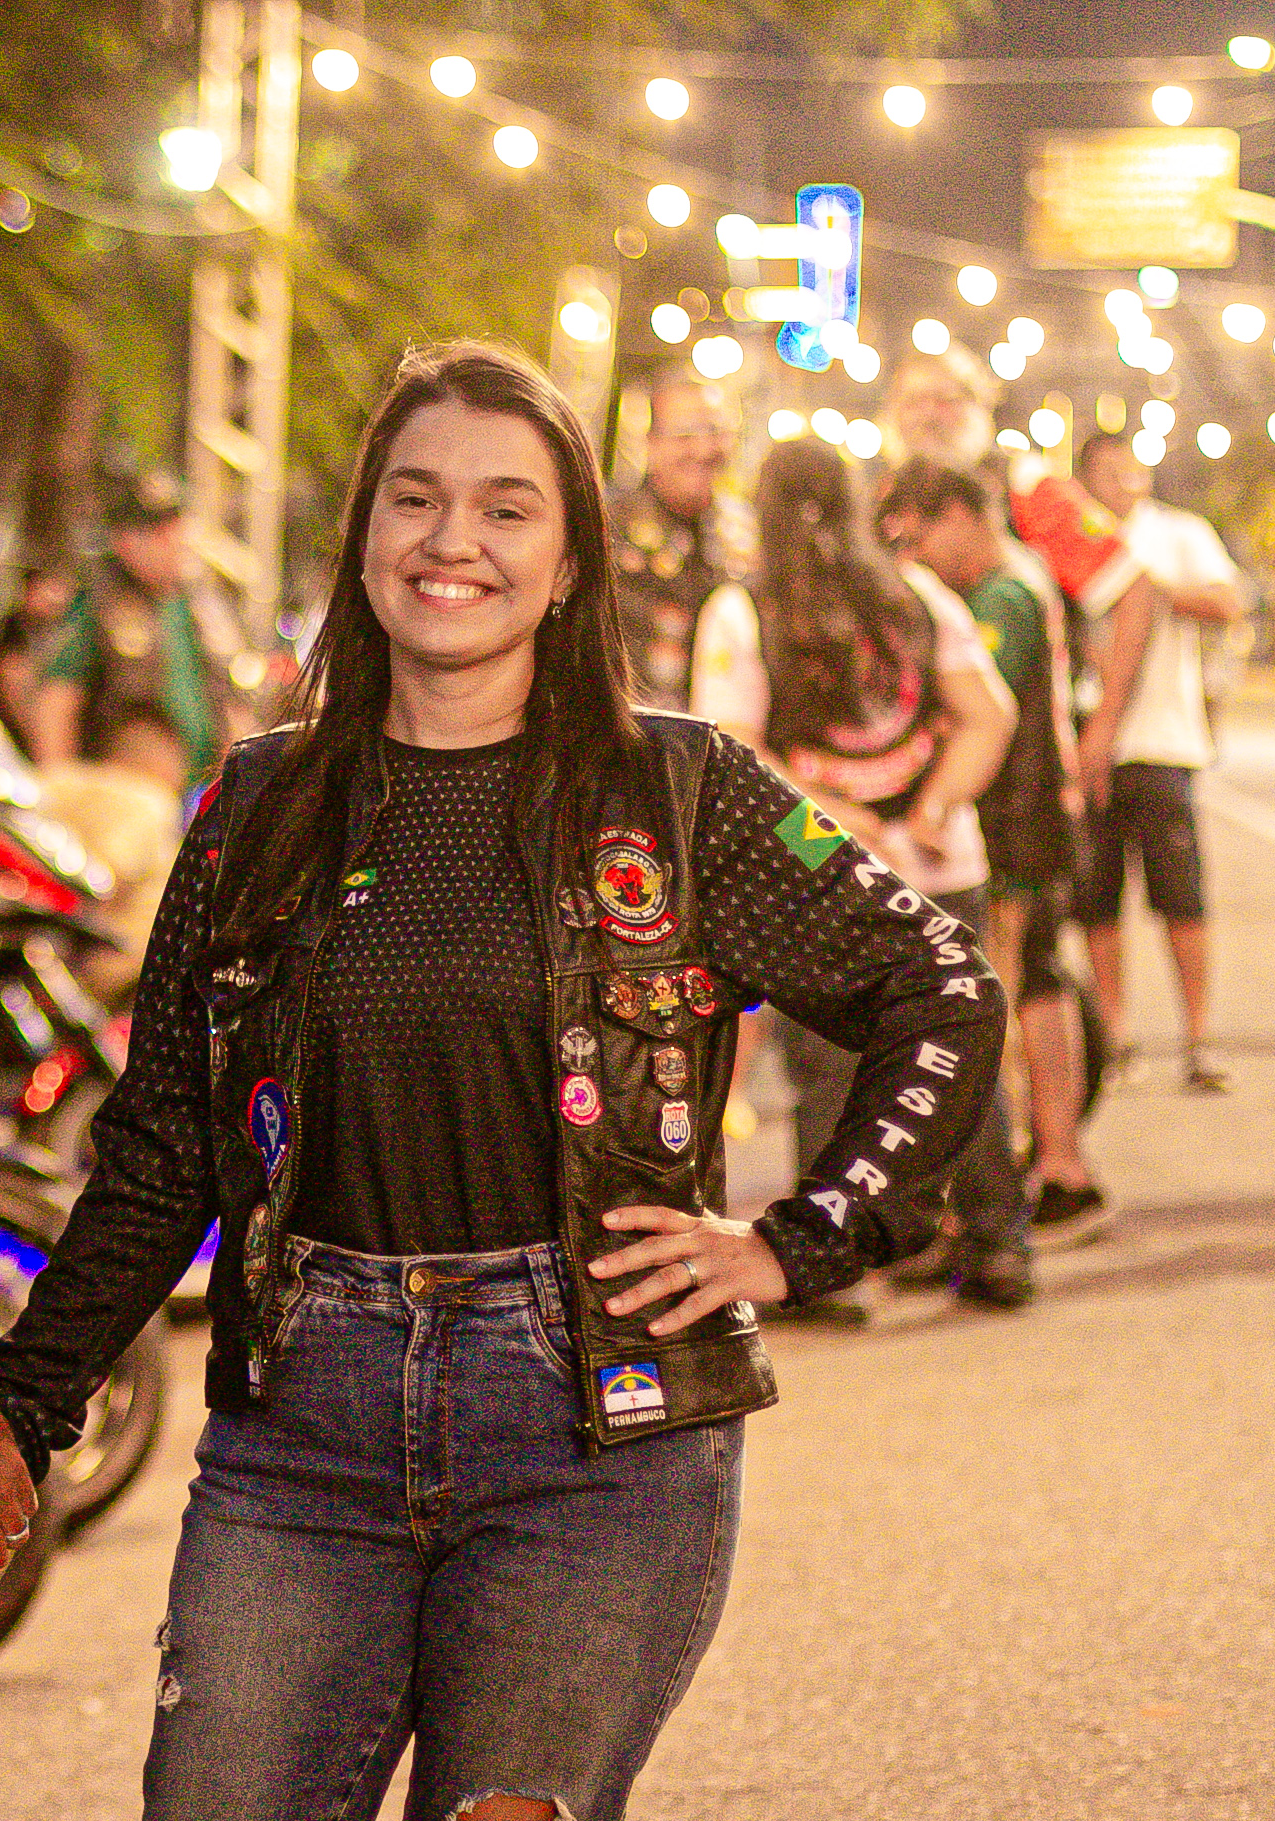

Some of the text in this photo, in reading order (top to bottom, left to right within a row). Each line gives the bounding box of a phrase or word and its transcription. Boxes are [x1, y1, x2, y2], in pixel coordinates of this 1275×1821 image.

[342, 891, 369, 908] A+
[610, 920, 673, 942] FORTALEZA-CE
[854, 853, 980, 1000] NOSSA
[665, 1110, 686, 1121] ROTA
[665, 1122, 687, 1141] 060
[608, 1409, 666, 1428] PERNAMBUCO
